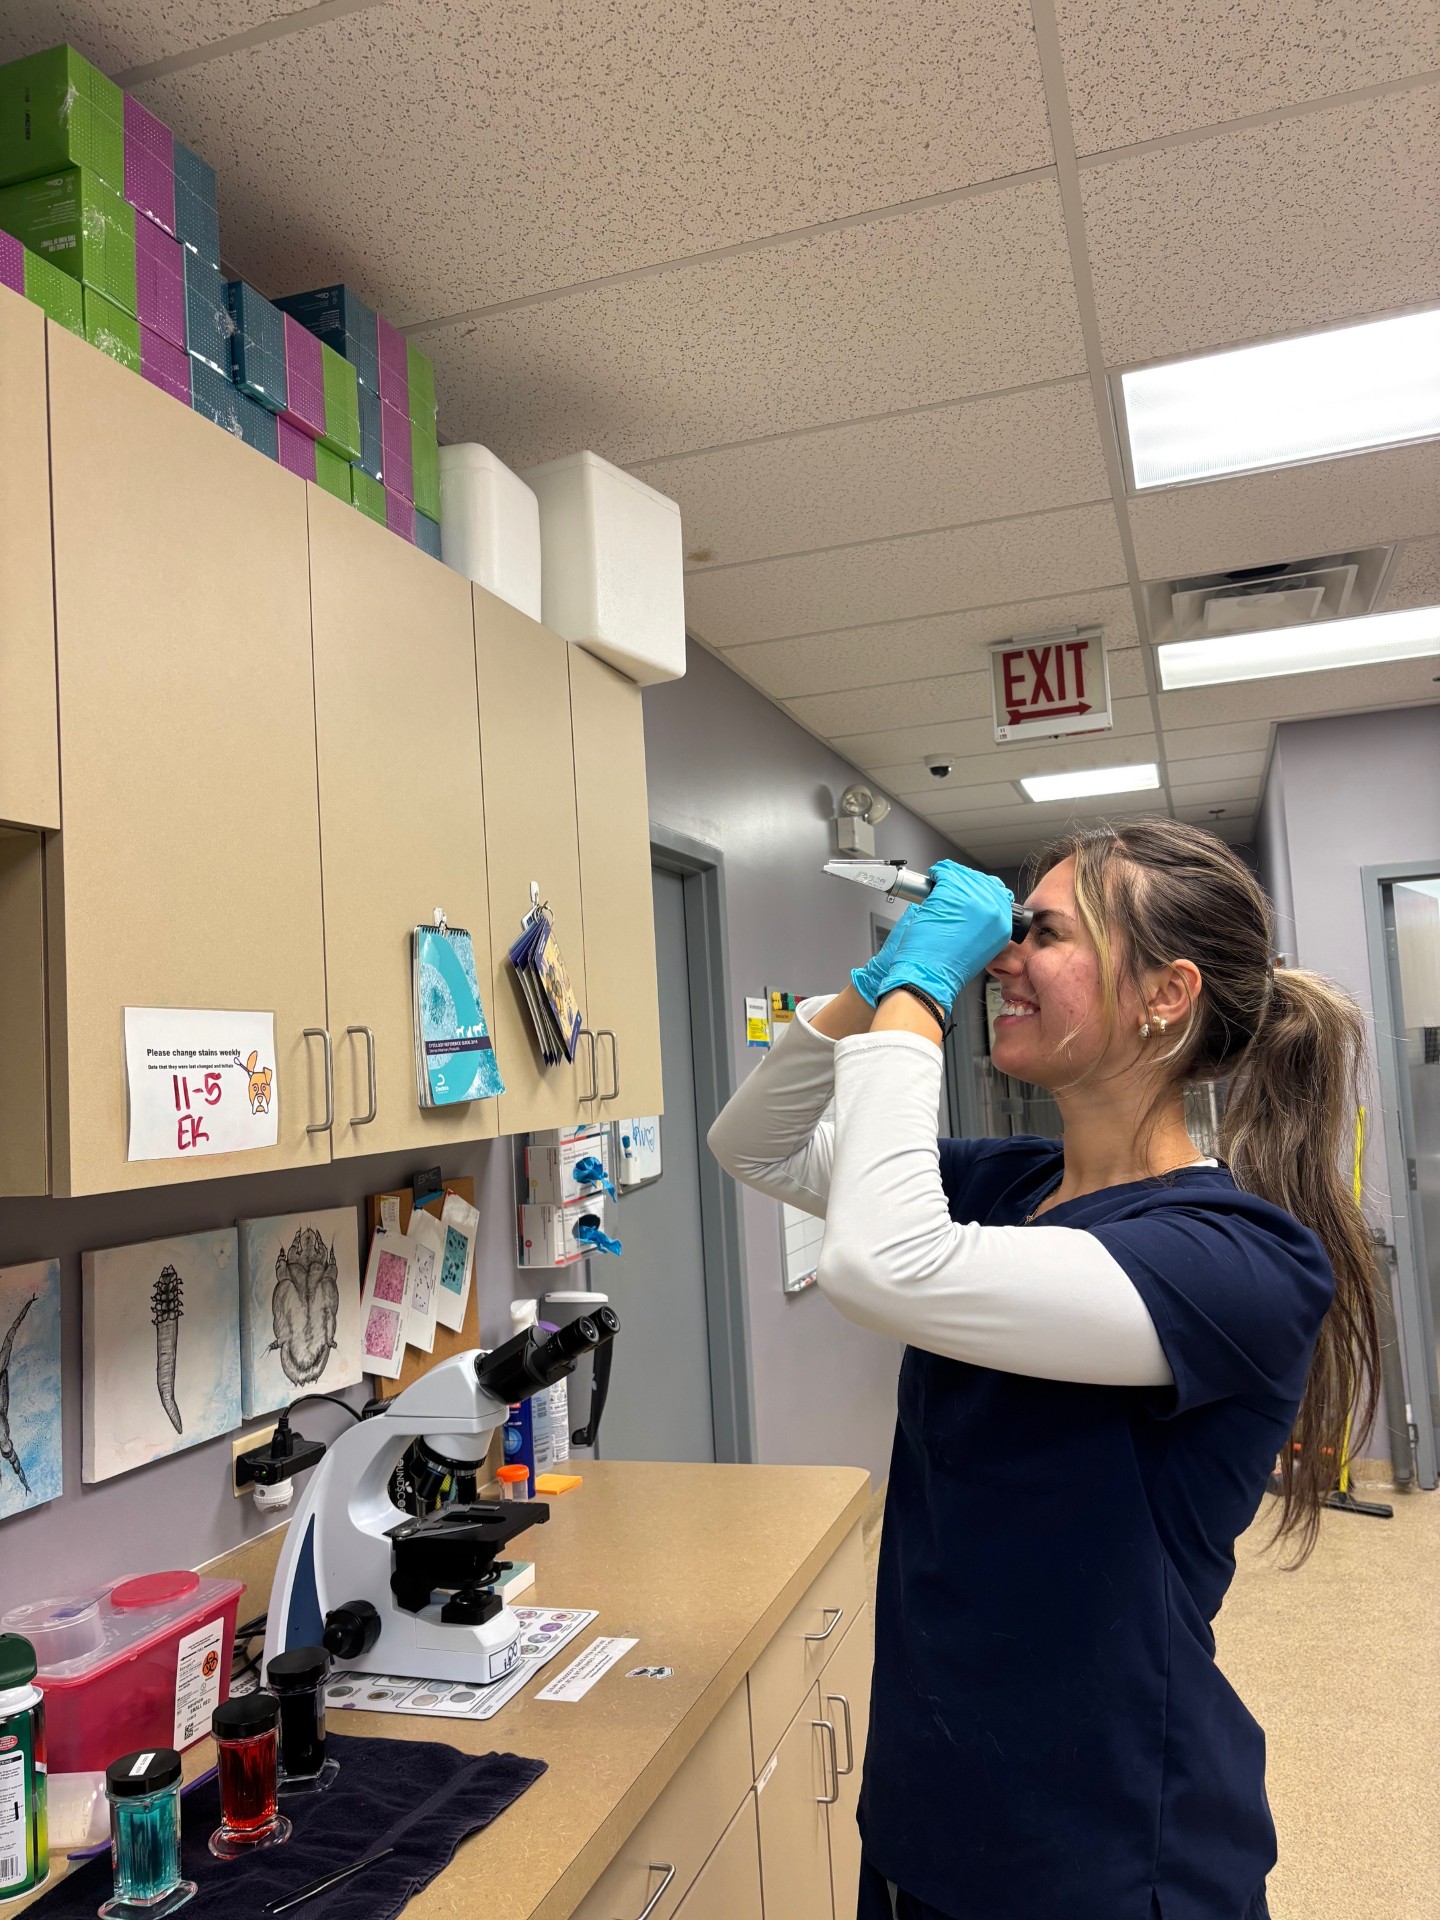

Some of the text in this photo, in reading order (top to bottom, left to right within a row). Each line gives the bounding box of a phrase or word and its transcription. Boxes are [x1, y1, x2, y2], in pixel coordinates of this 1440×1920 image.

[1002, 641, 1089, 708] EXIT
[146, 1048, 241, 1058] Please change stains weekly
[172, 1072, 223, 1112] 11-5
[177, 1113, 210, 1150] EK
